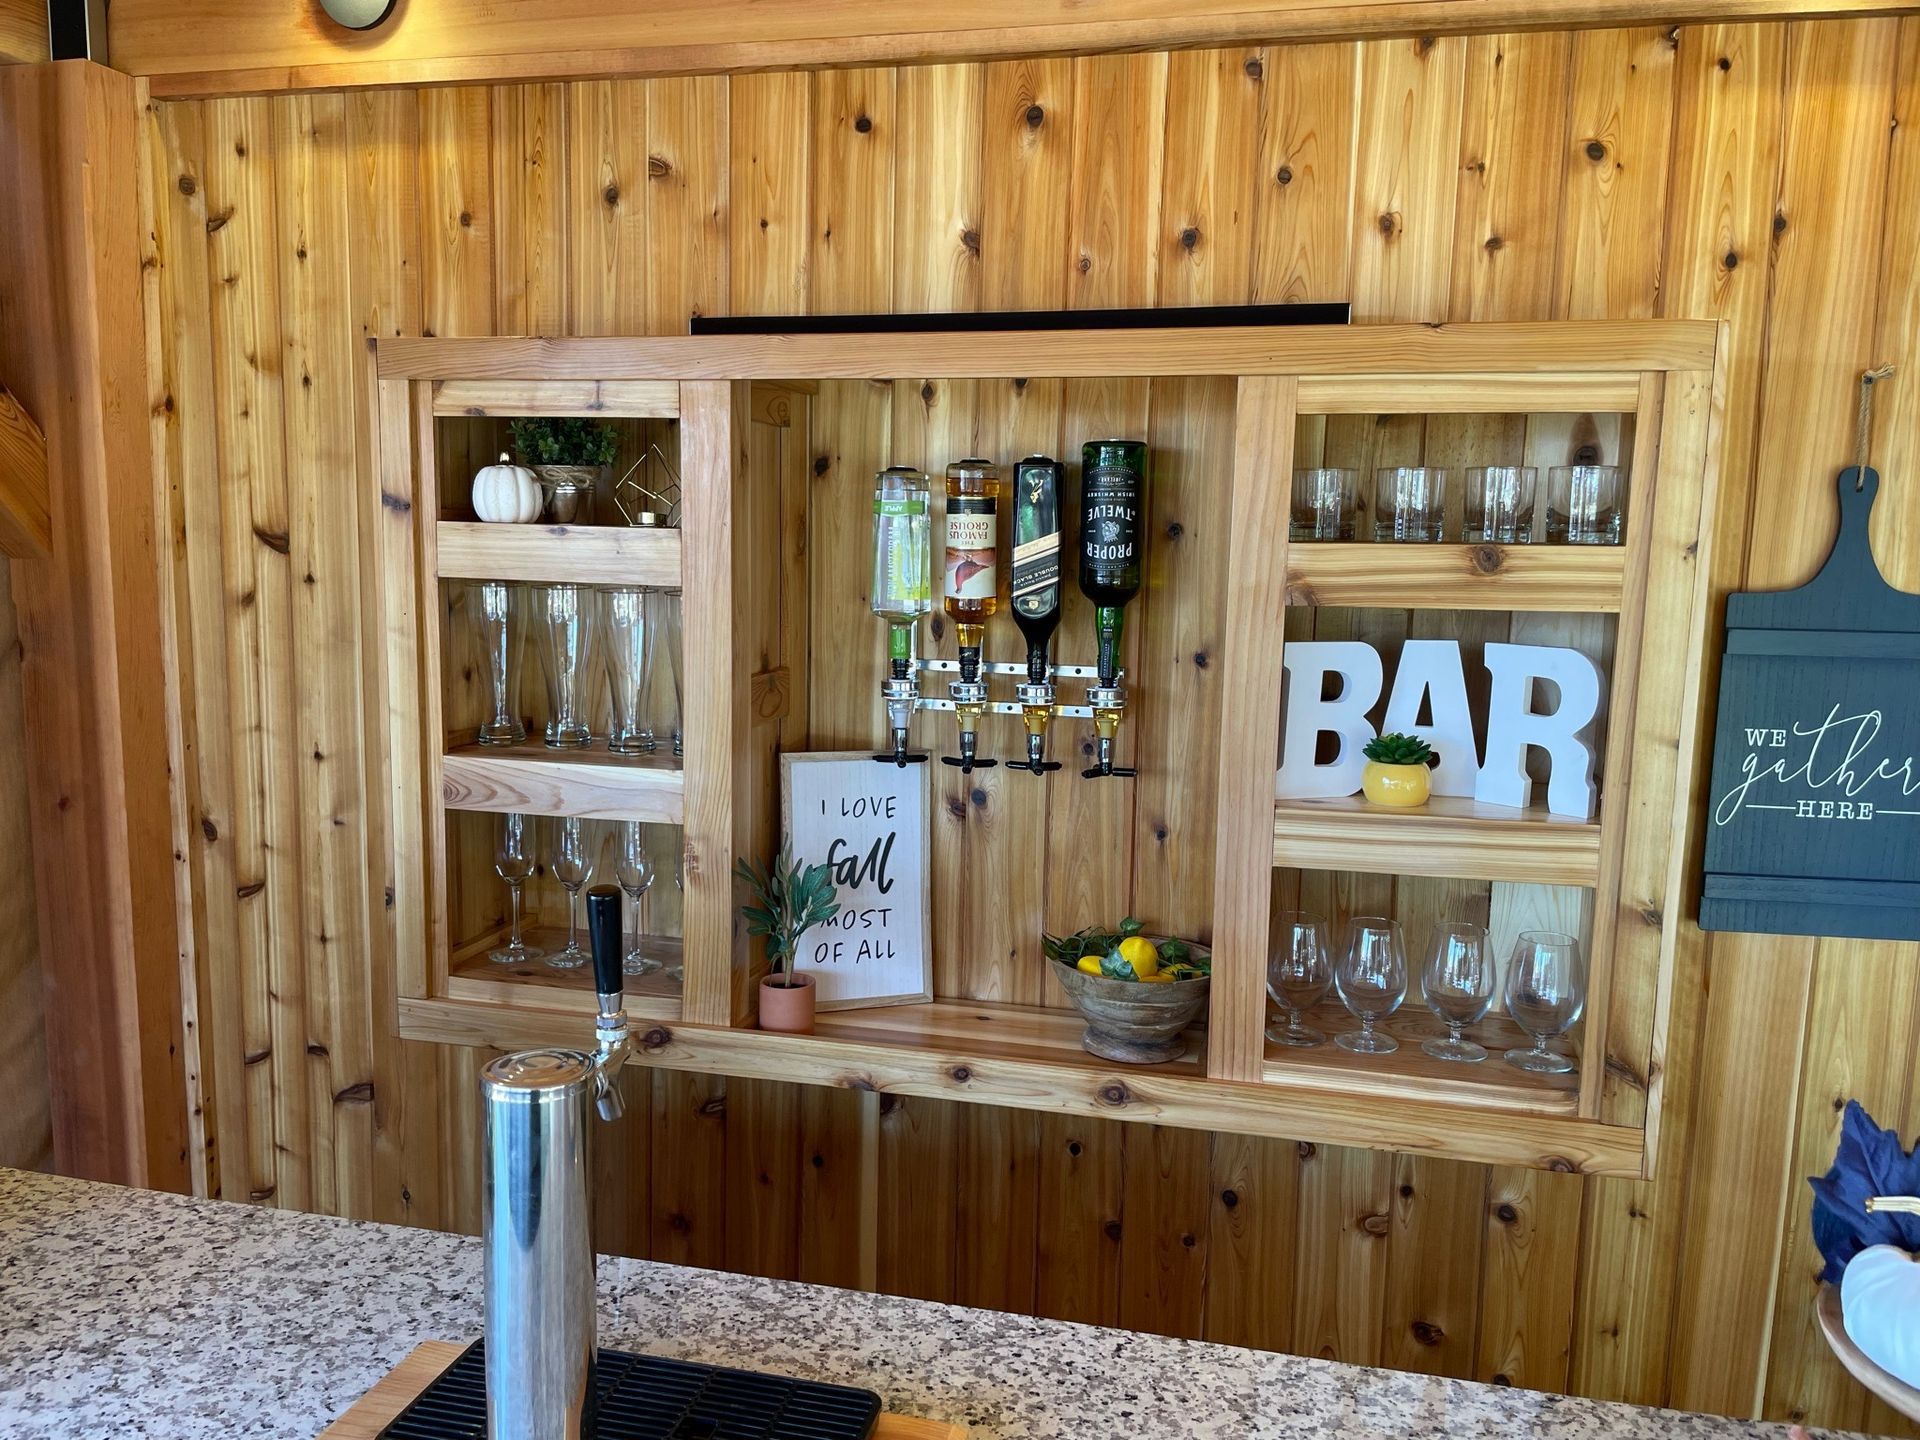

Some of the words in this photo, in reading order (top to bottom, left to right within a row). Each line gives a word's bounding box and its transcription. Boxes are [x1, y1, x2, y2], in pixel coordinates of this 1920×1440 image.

[1087, 504, 1133, 521] TWELVE
[949, 521, 989, 530] GROUSE
[949, 531, 988, 540] FAMOUS
[1086, 541, 1133, 560] PROPER
[1033, 564, 1059, 578] DOUBLE
[1275, 639, 1598, 819] BAR
[1744, 728, 1787, 747] WE
[1715, 703, 1920, 826] gather
[820, 799, 826, 816] I
[841, 796, 897, 819] LOVE
[1795, 800, 1874, 820] HERE
[826, 831, 896, 895] fall
[820, 908, 892, 931] MOST
[814, 942, 844, 964] OF
[856, 939, 896, 964] ALL
